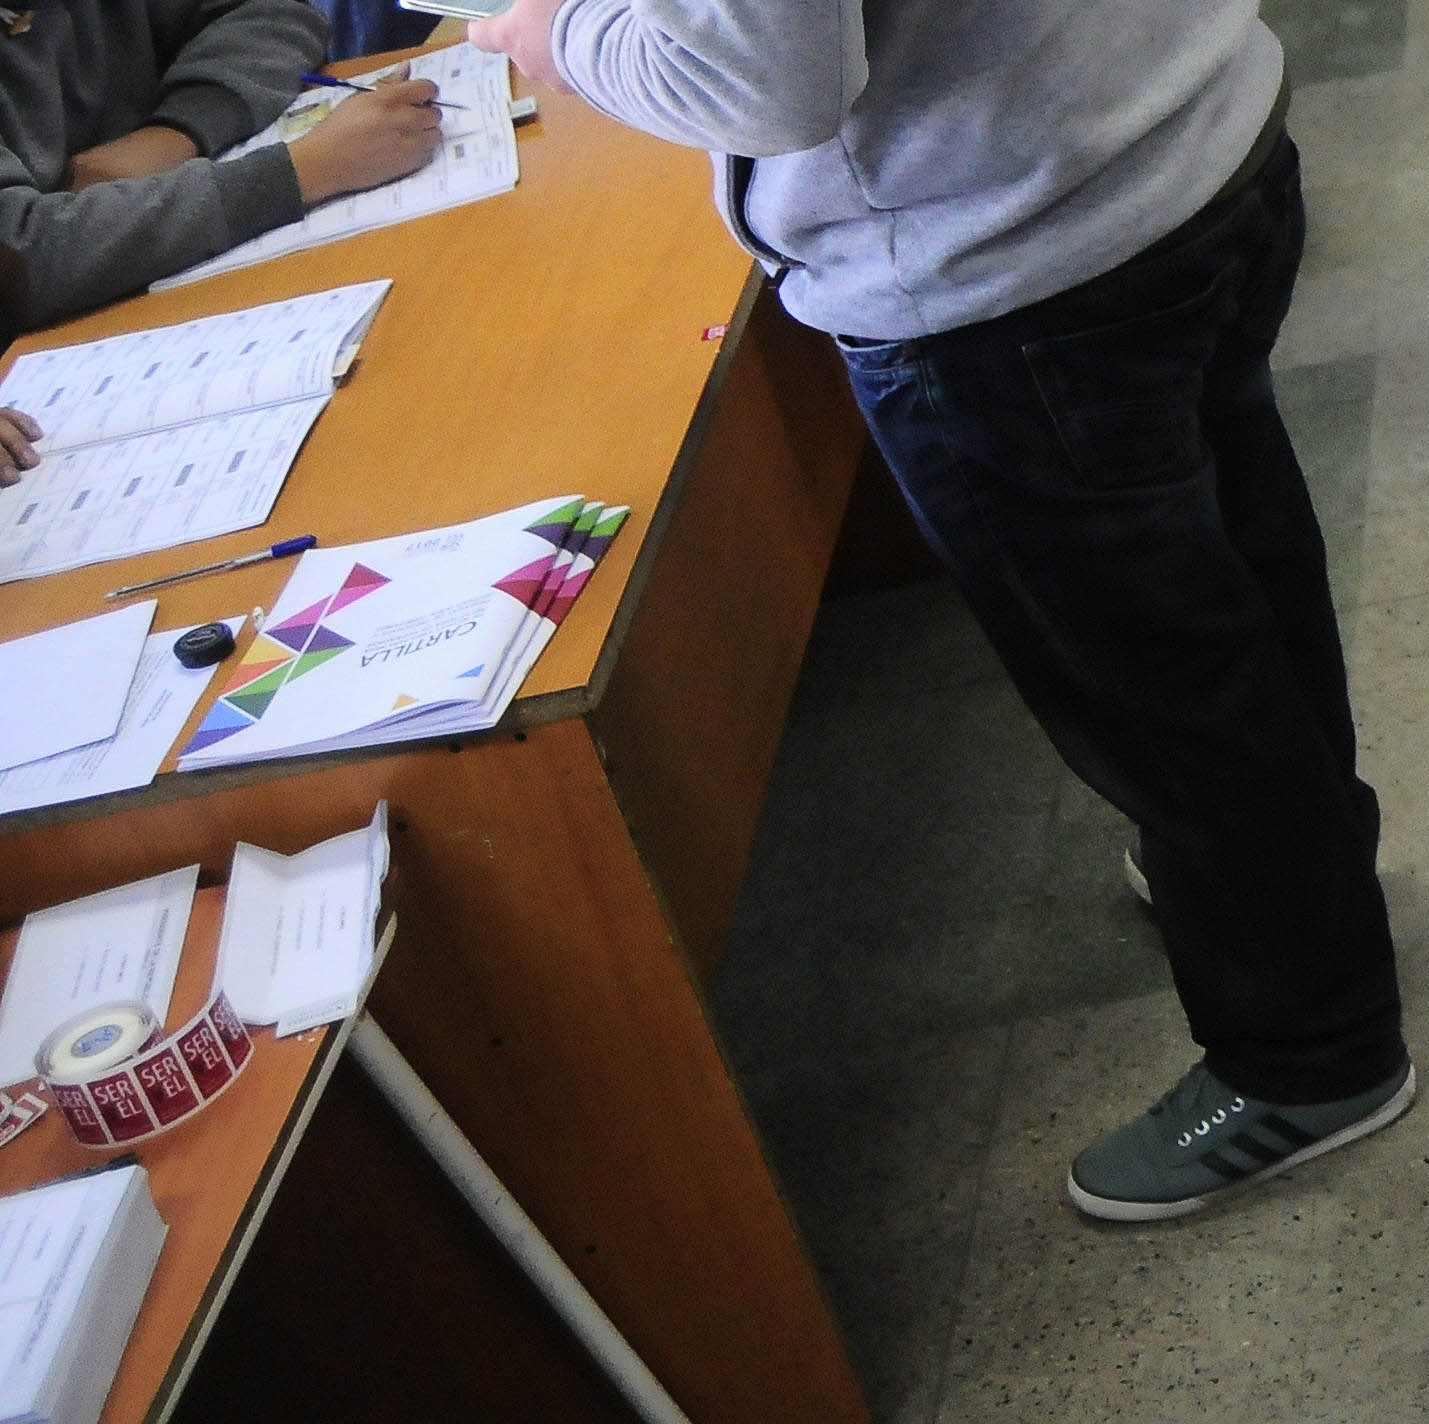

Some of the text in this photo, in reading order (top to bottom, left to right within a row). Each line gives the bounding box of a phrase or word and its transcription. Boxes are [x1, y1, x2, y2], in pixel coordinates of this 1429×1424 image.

[361, 621, 477, 667] CARTILLA
[184, 1027, 214, 1060] SER
[140, 1054, 179, 1087] SER
[94, 1079, 134, 1105] SER
